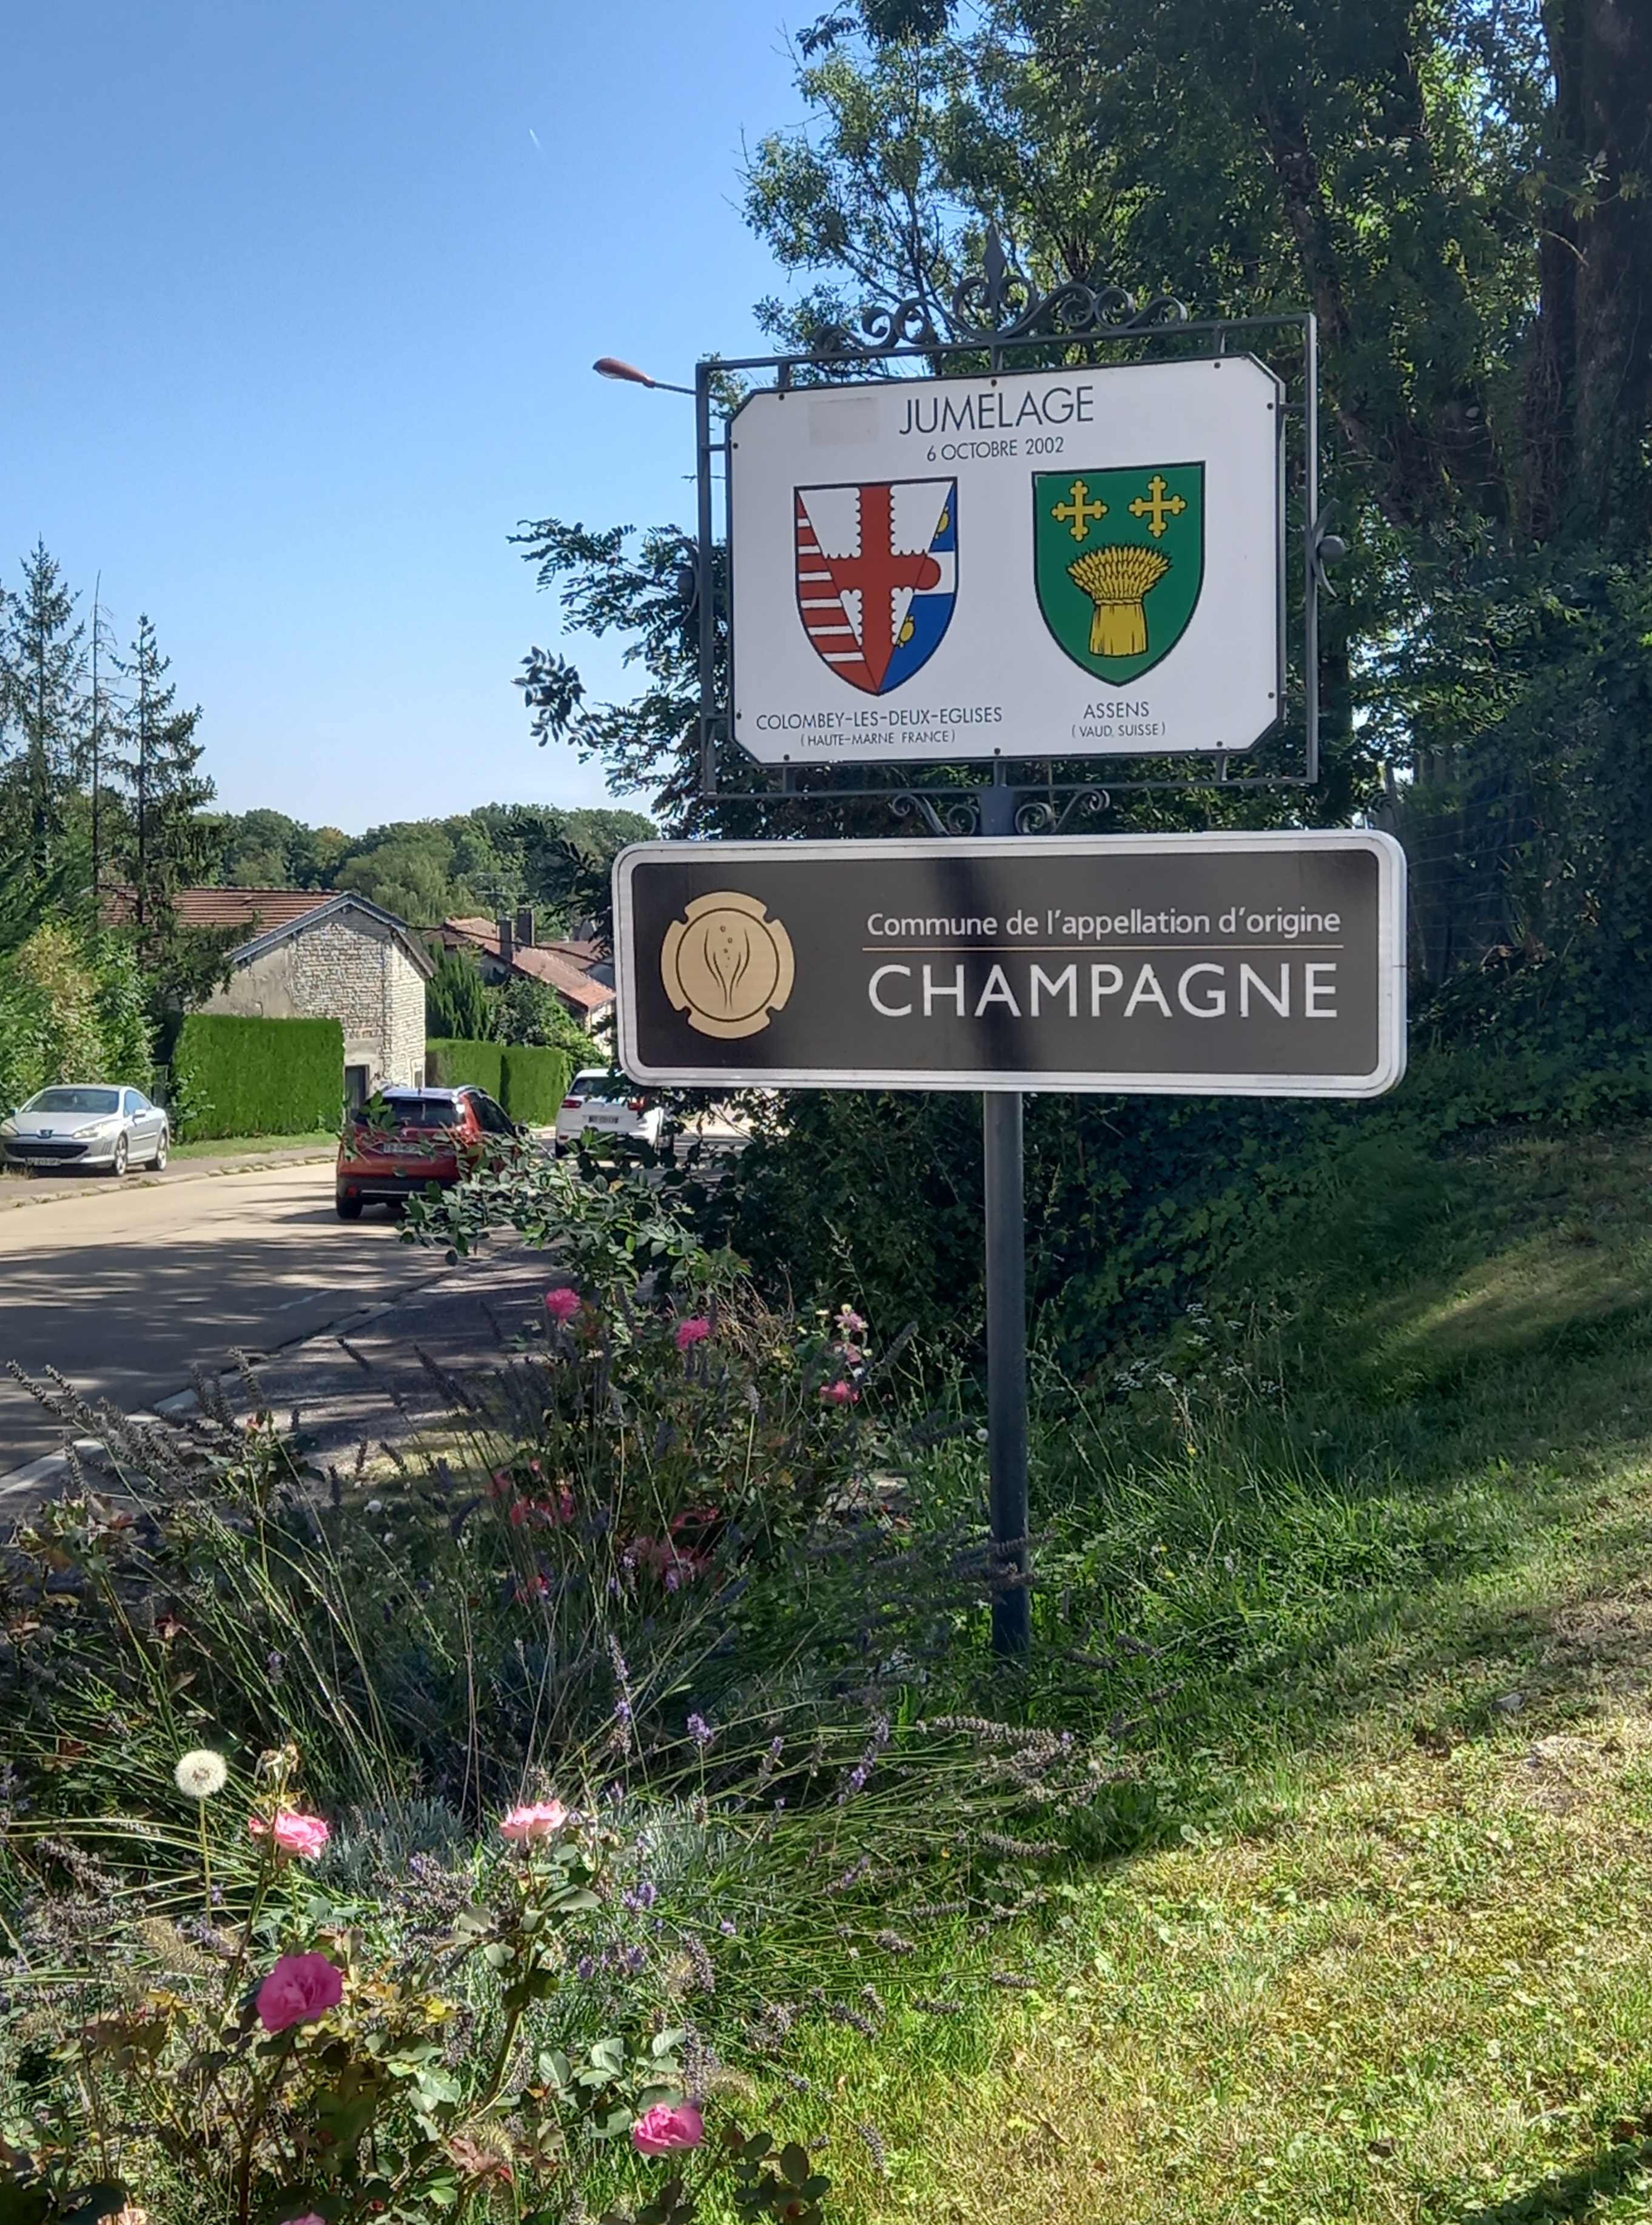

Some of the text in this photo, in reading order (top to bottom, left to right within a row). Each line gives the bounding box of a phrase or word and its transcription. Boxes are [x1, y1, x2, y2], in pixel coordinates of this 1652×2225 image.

[899, 385, 1094, 435] JUMELAGE
[927, 436, 1064, 462] 6 OCTOBRE 2002
[756, 706, 1002, 731] COLOMBEY-LES-DEUX-EGLISES
[1083, 701, 1150, 720] ASSENS
[800, 729, 956, 748] (HAUTE-MARNE FRANCE)
[1118, 721, 1166, 737] SUISSE)
[867, 913, 998, 936] Commune
[1006, 909, 1039, 936] de
[868, 962, 1337, 1018] CHAMPAGNE
